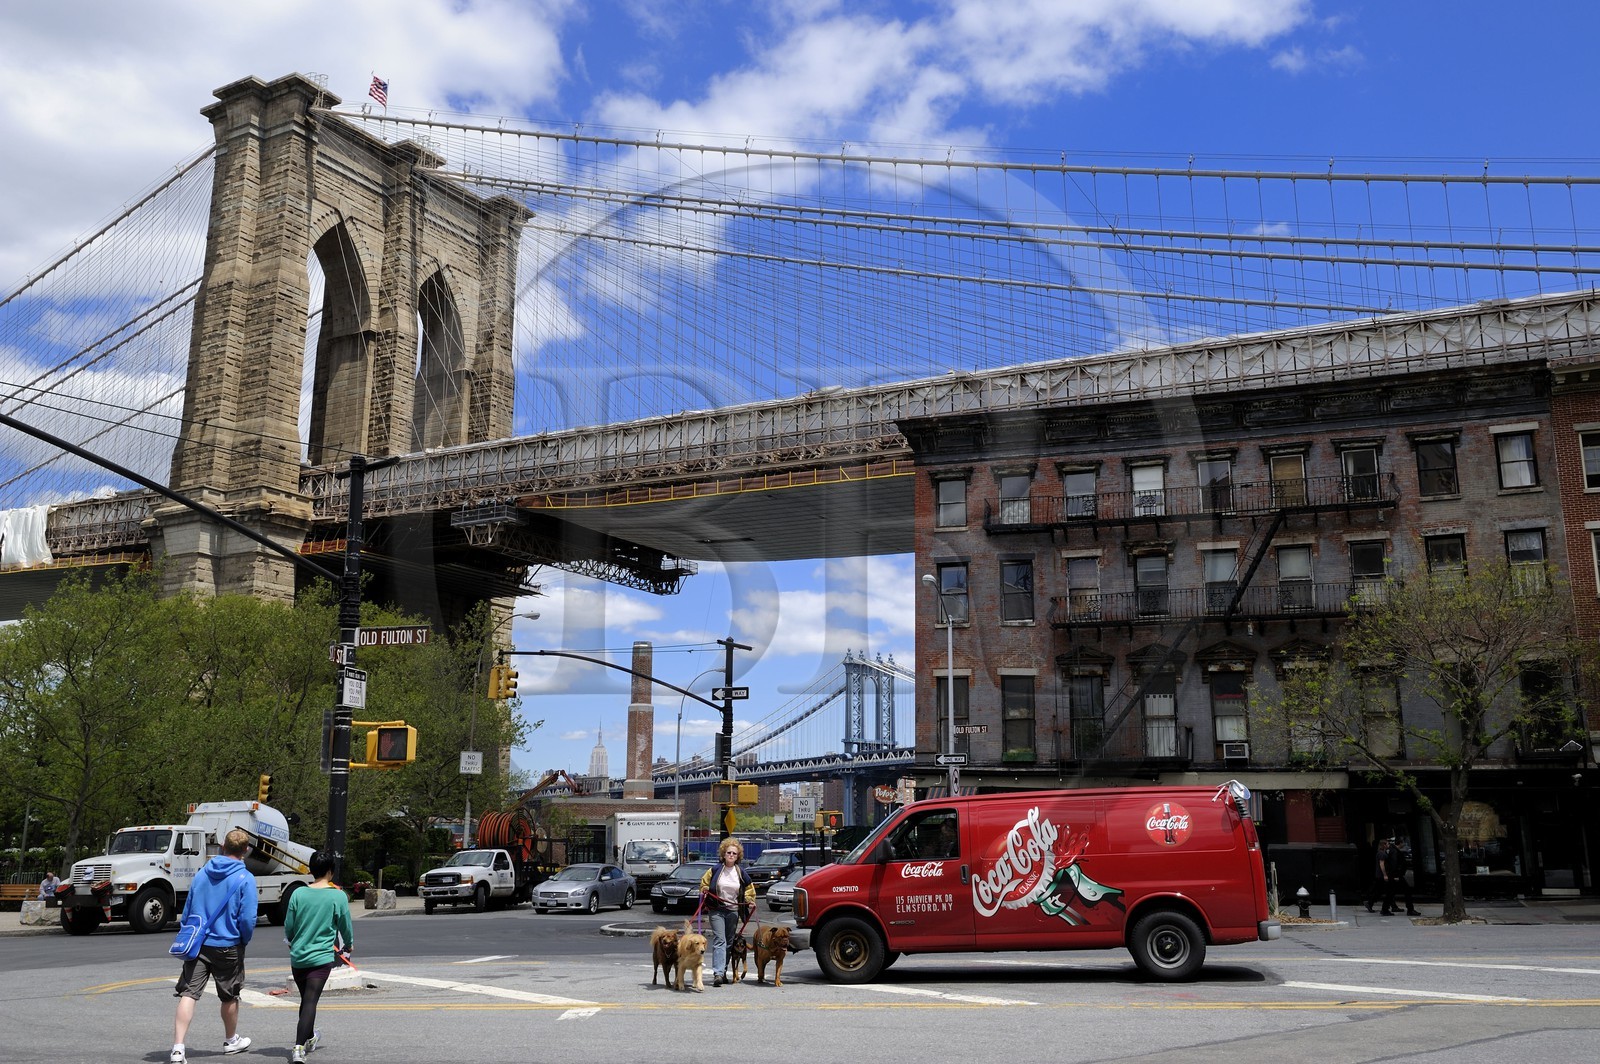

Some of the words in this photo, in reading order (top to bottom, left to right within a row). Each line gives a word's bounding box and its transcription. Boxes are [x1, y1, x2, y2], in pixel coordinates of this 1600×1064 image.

[360, 631, 378, 646] OLD
[380, 629, 413, 645] FULTON
[416, 629, 428, 644] ST
[1146, 814, 1190, 830] Coca-Cola
[901, 861, 944, 878] Coca-Cola
[972, 806, 1060, 918] Coca-Cola
[1018, 870, 1040, 894] CLASSIC
[896, 896, 904, 904] 115
[906, 894, 933, 904] FAIRVIEW
[935, 894, 943, 903] PK
